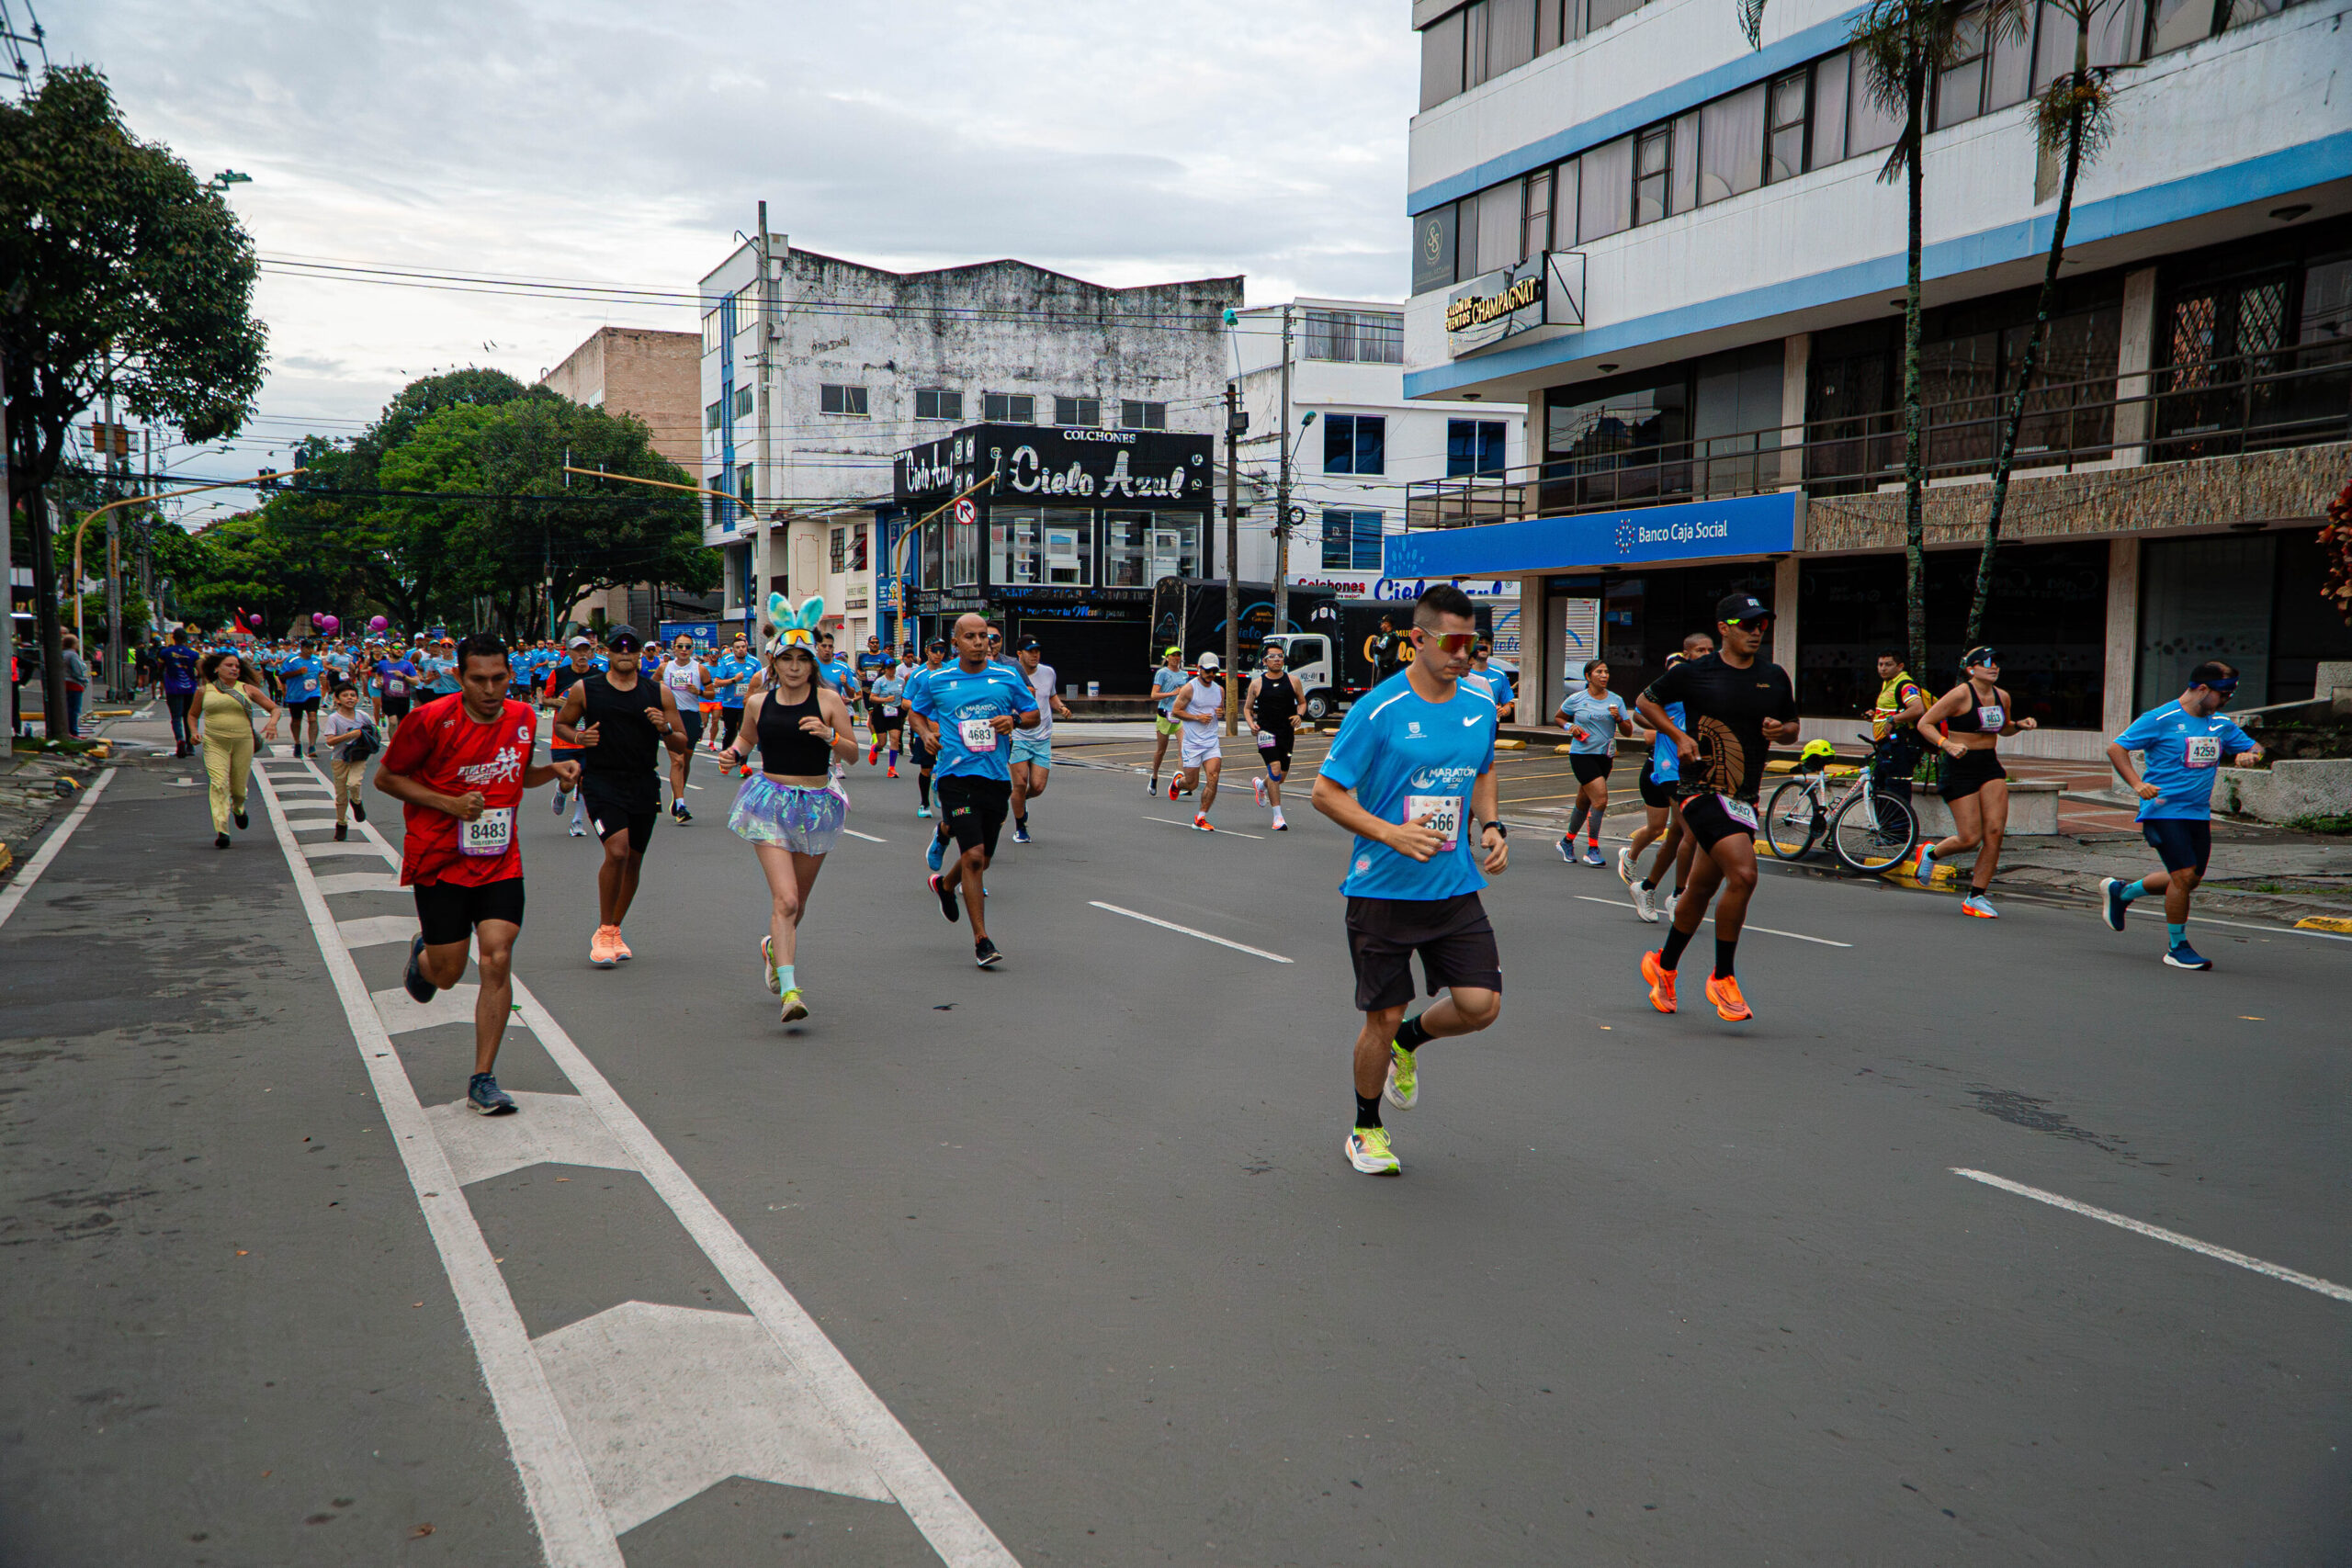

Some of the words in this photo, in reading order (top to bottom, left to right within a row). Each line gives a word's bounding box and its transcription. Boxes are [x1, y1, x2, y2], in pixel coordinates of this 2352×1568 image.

[1472, 277, 1536, 324] CHAMPAGNAT
[1064, 430, 1136, 444] COLCHONES
[1011, 445, 1094, 496] Cielo
[1100, 450, 1186, 499] Azul
[1638, 526, 1668, 543] Banco
[1670, 523, 1693, 544] Caja
[1695, 519, 1727, 539] Social
[1374, 577, 1425, 601] Ciel
[1238, 626, 1262, 639] ielo
[517, 726, 530, 740] G
[968, 729, 991, 740] 4683
[2193, 746, 2216, 758] 4259
[1429, 765, 1476, 778] MARATÓN
[470, 822, 506, 840] 8483
